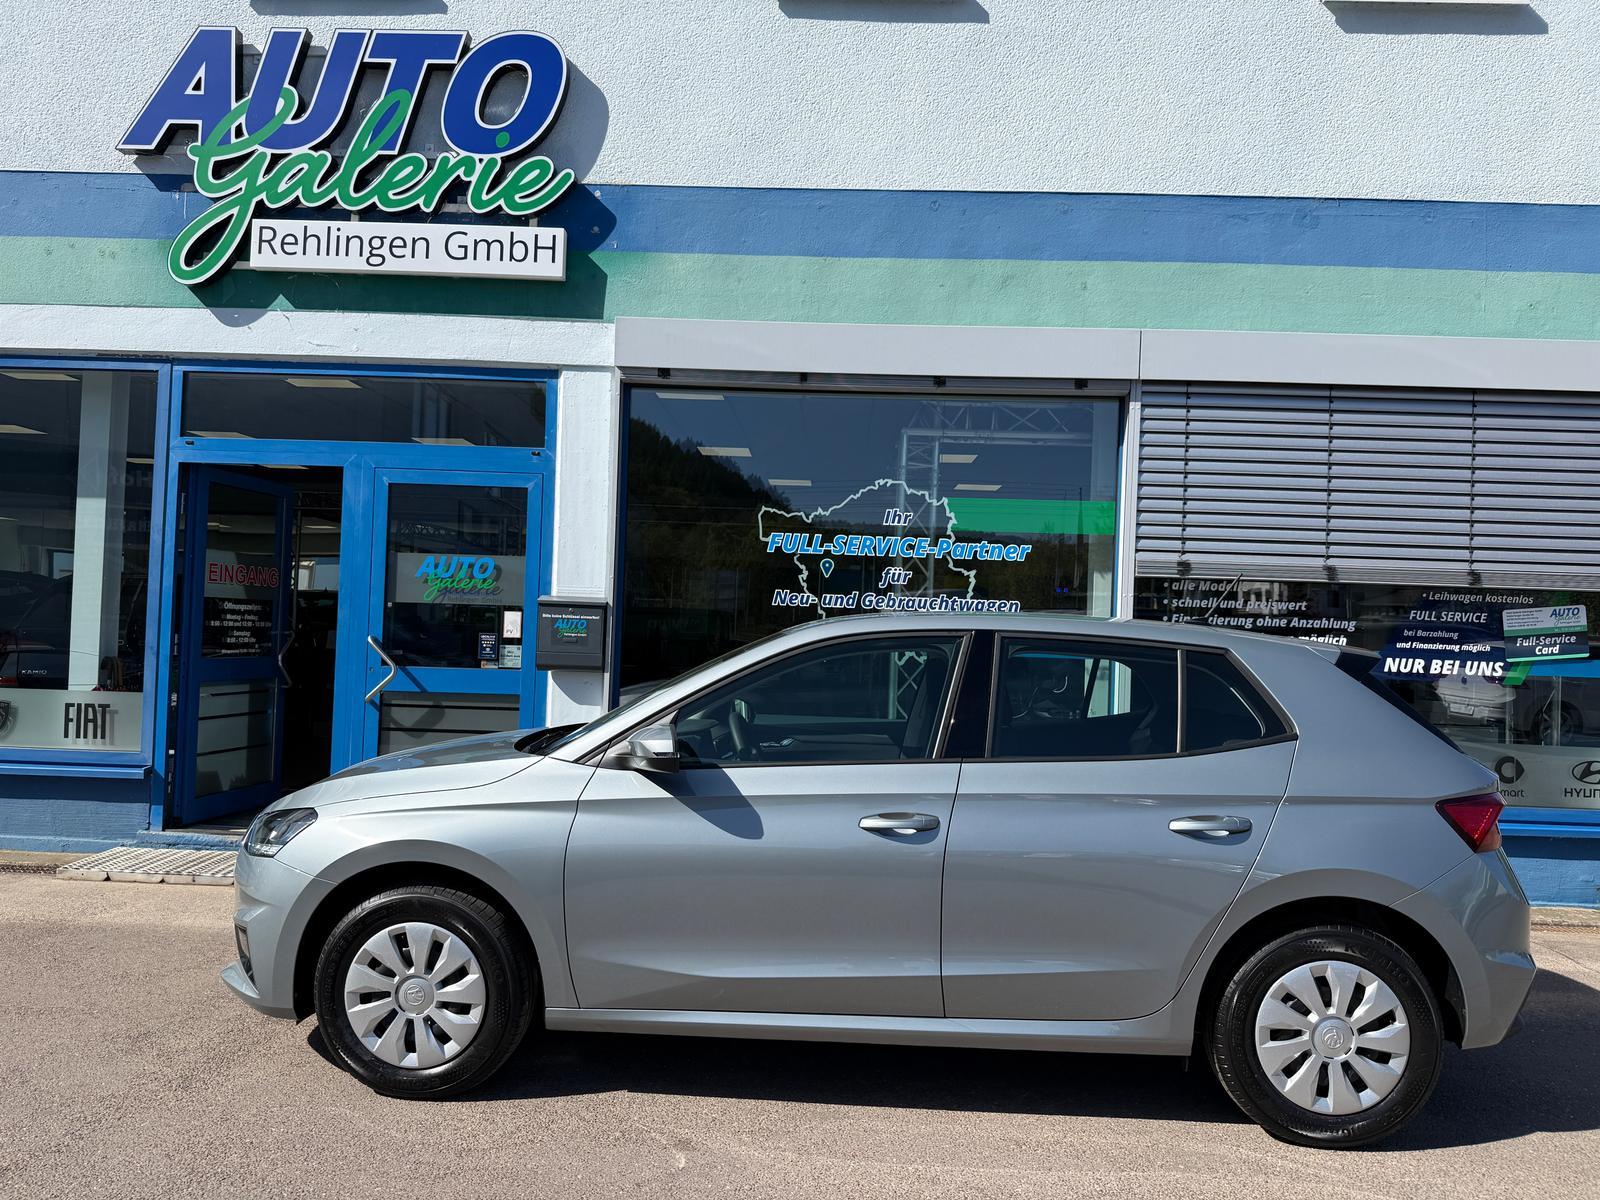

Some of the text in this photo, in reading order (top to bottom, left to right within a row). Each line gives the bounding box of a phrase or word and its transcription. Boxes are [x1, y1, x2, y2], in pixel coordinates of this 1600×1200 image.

[117, 26, 567, 157] AUTO
[257, 225, 558, 267] Rehlingen GmbH
[883, 509, 913, 525] Ihr
[767, 533, 1032, 561] FULL-SERVICE-Partner
[415, 556, 496, 579] AUTO
[208, 562, 280, 588] EINGANG
[879, 567, 912, 588] für
[1172, 580, 1195, 590] alle
[772, 590, 1021, 612] Neu- und Gebrauchtwagen
[1429, 592, 1534, 604] Leihwagen kostenlos
[1219, 599, 1244, 609] und
[1246, 599, 1308, 612] preiswert
[1550, 607, 1580, 618] AUTO
[1409, 610, 1488, 622] FULL SERVICE
[554, 619, 587, 629] AUTO
[1256, 616, 1287, 627] ohne
[1289, 618, 1357, 632] Anzahlung
[1403, 629, 1459, 640] bei Barzahlung
[1516, 634, 1577, 646] Full-Service
[1411, 642, 1460, 653] Finanzierung
[1461, 643, 1491, 653] möglich
[1535, 645, 1559, 655] Card
[1383, 657, 1504, 677] NUR BEI UNS
[64, 702, 111, 740] FIAT
[1500, 788, 1525, 798] mart
